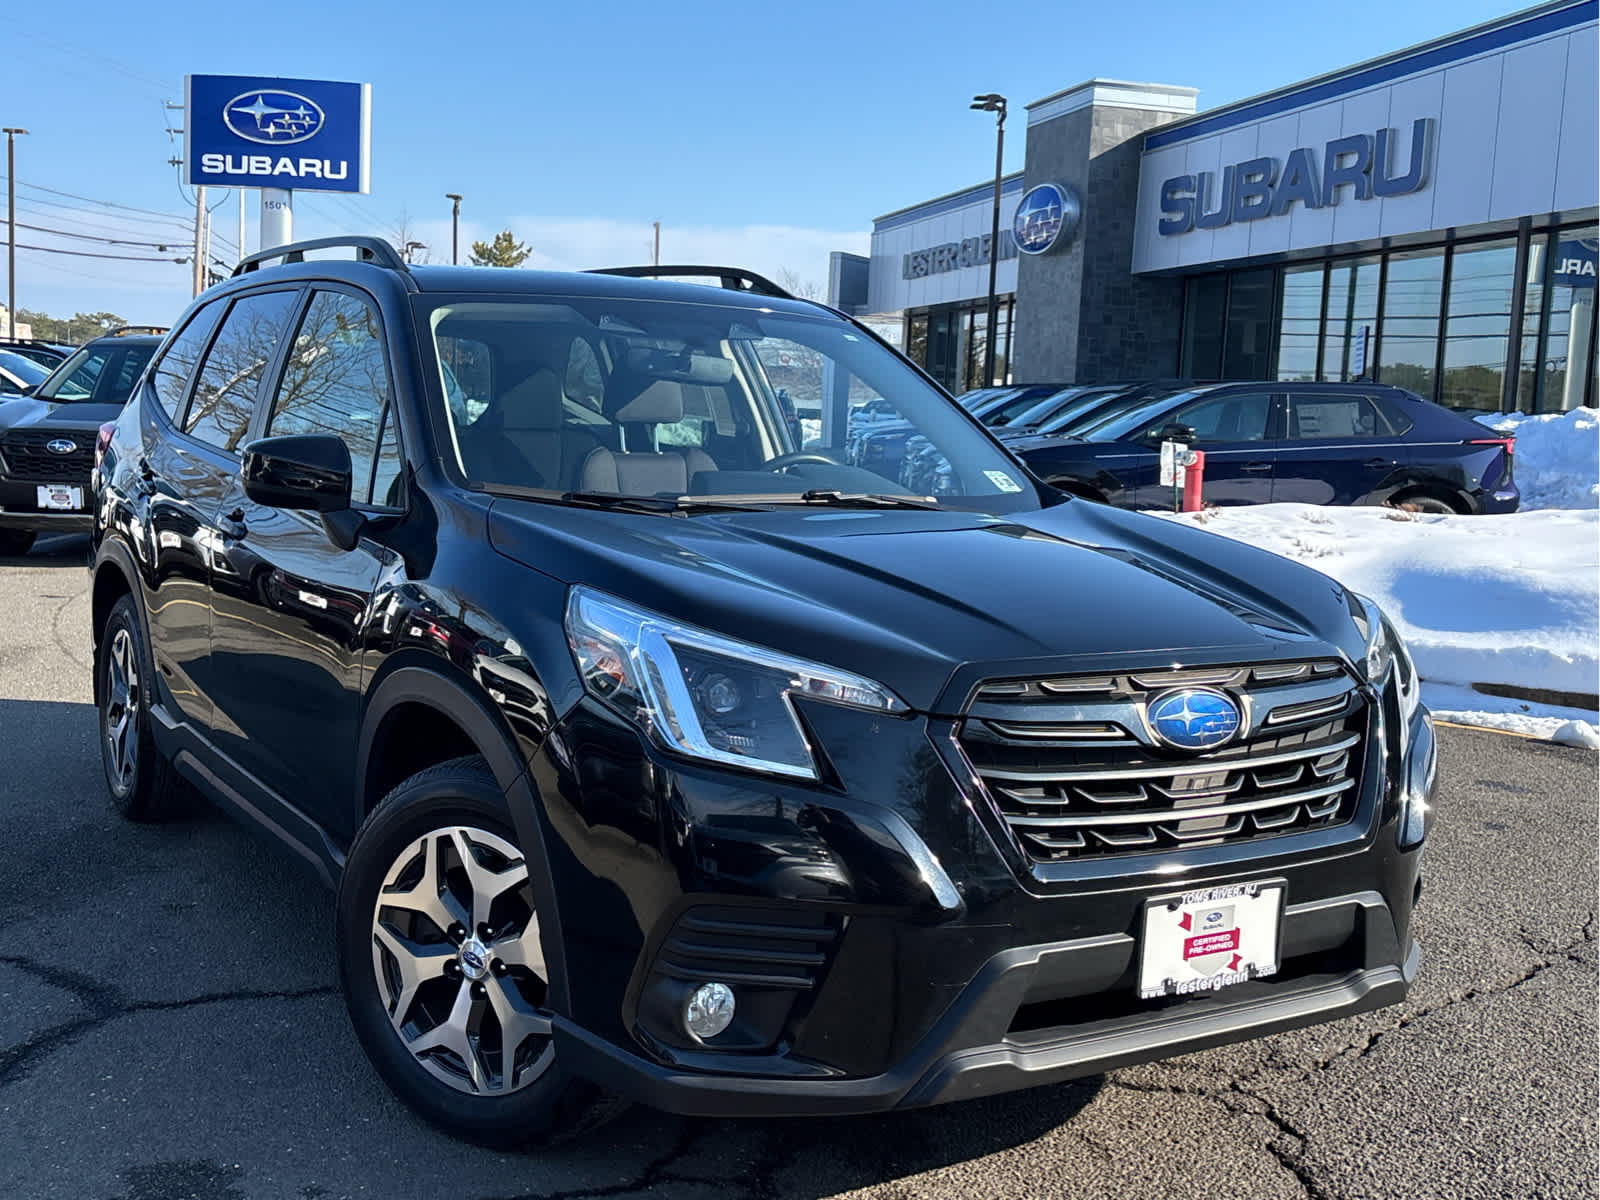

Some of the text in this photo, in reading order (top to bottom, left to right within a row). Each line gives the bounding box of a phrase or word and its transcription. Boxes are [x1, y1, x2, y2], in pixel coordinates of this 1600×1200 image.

[201, 153, 347, 180] SUBARU
[1158, 118, 1435, 236] SUBARU
[902, 242, 959, 280] LESTER
[1183, 889, 1208, 905] TOMS
[1245, 883, 1258, 896] NJ
[1188, 941, 1234, 955] PRE-OWNED
[1193, 934, 1231, 947] CERTIFIED
